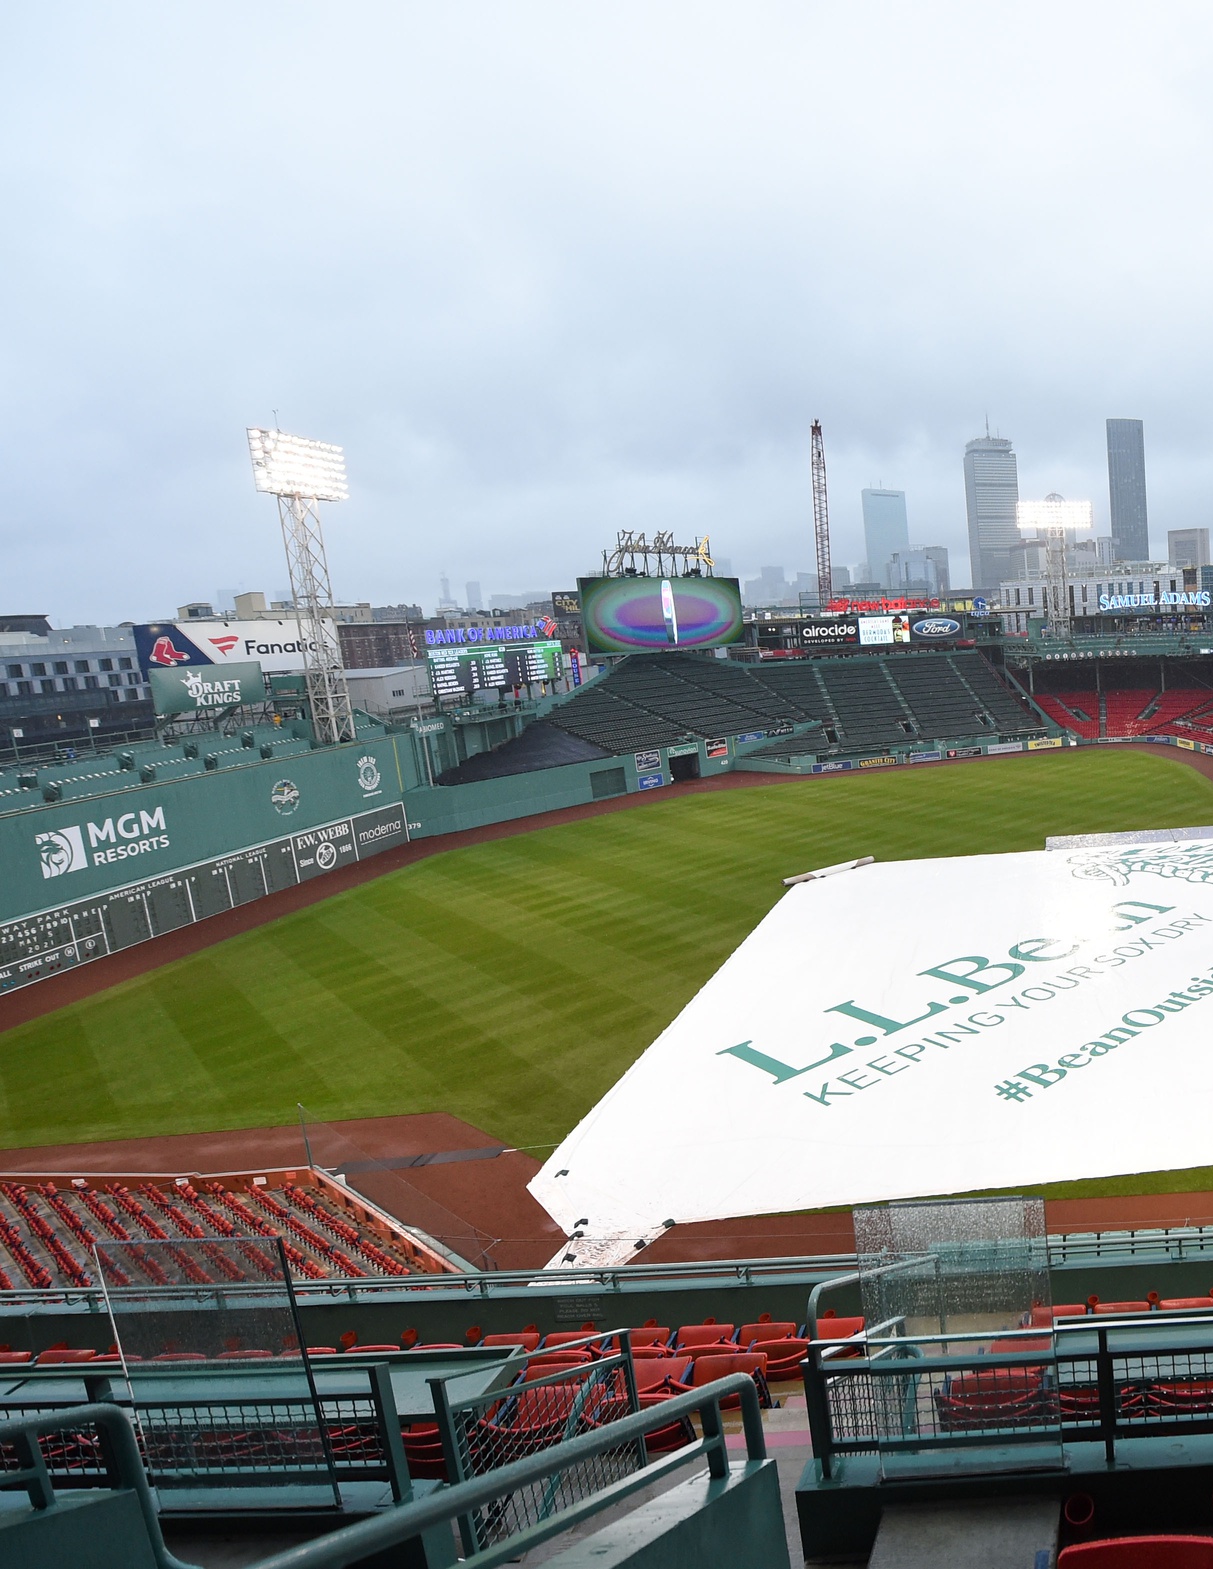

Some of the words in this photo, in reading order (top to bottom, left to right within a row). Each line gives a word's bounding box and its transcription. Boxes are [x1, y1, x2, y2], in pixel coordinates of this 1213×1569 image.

[881, 596, 941, 610] balance
[1099, 593, 1157, 611] SAMUEL
[1159, 590, 1211, 606] ADAMS
[425, 628, 466, 645] BANK
[467, 627, 484, 643] OF
[486, 625, 538, 641] AMERICA
[803, 623, 857, 637] airocide
[922, 621, 951, 634] Ford
[188, 678, 241, 698] DRAFT
[196, 692, 242, 707] KINGS
[821, 762, 843, 771] jetBlue
[860, 758, 883, 767] GRANITE
[87, 806, 167, 848] MGM
[296, 832, 318, 850] F.W.
[317, 823, 350, 842] WEBB
[359, 820, 401, 842] moderna
[408, 822, 422, 831] 379
[93, 835, 170, 867] RESORTS
[215, 855, 244, 867] NATIONAL
[245, 847, 267, 858] LEAGUE
[300, 857, 314, 868] Since
[339, 843, 352, 854] 1866
[109, 885, 146, 901] AMERICAN
[148, 876, 175, 889] LEAGUE
[1, 922, 28, 934] WAY
[37, 909, 70, 923] PARK
[19, 936, 38, 947] MAY
[28, 940, 54, 954] 2021
[19, 958, 43, 972] STRIKE
[45, 952, 60, 963] OUT
[716, 900, 1177, 1085] L.L.Ben
[803, 1011, 1005, 1107] KEEPING
[995, 966, 1105, 1010] YOUR
[1094, 937, 1165, 967] SOX
[1151, 912, 1213, 939] DRY
